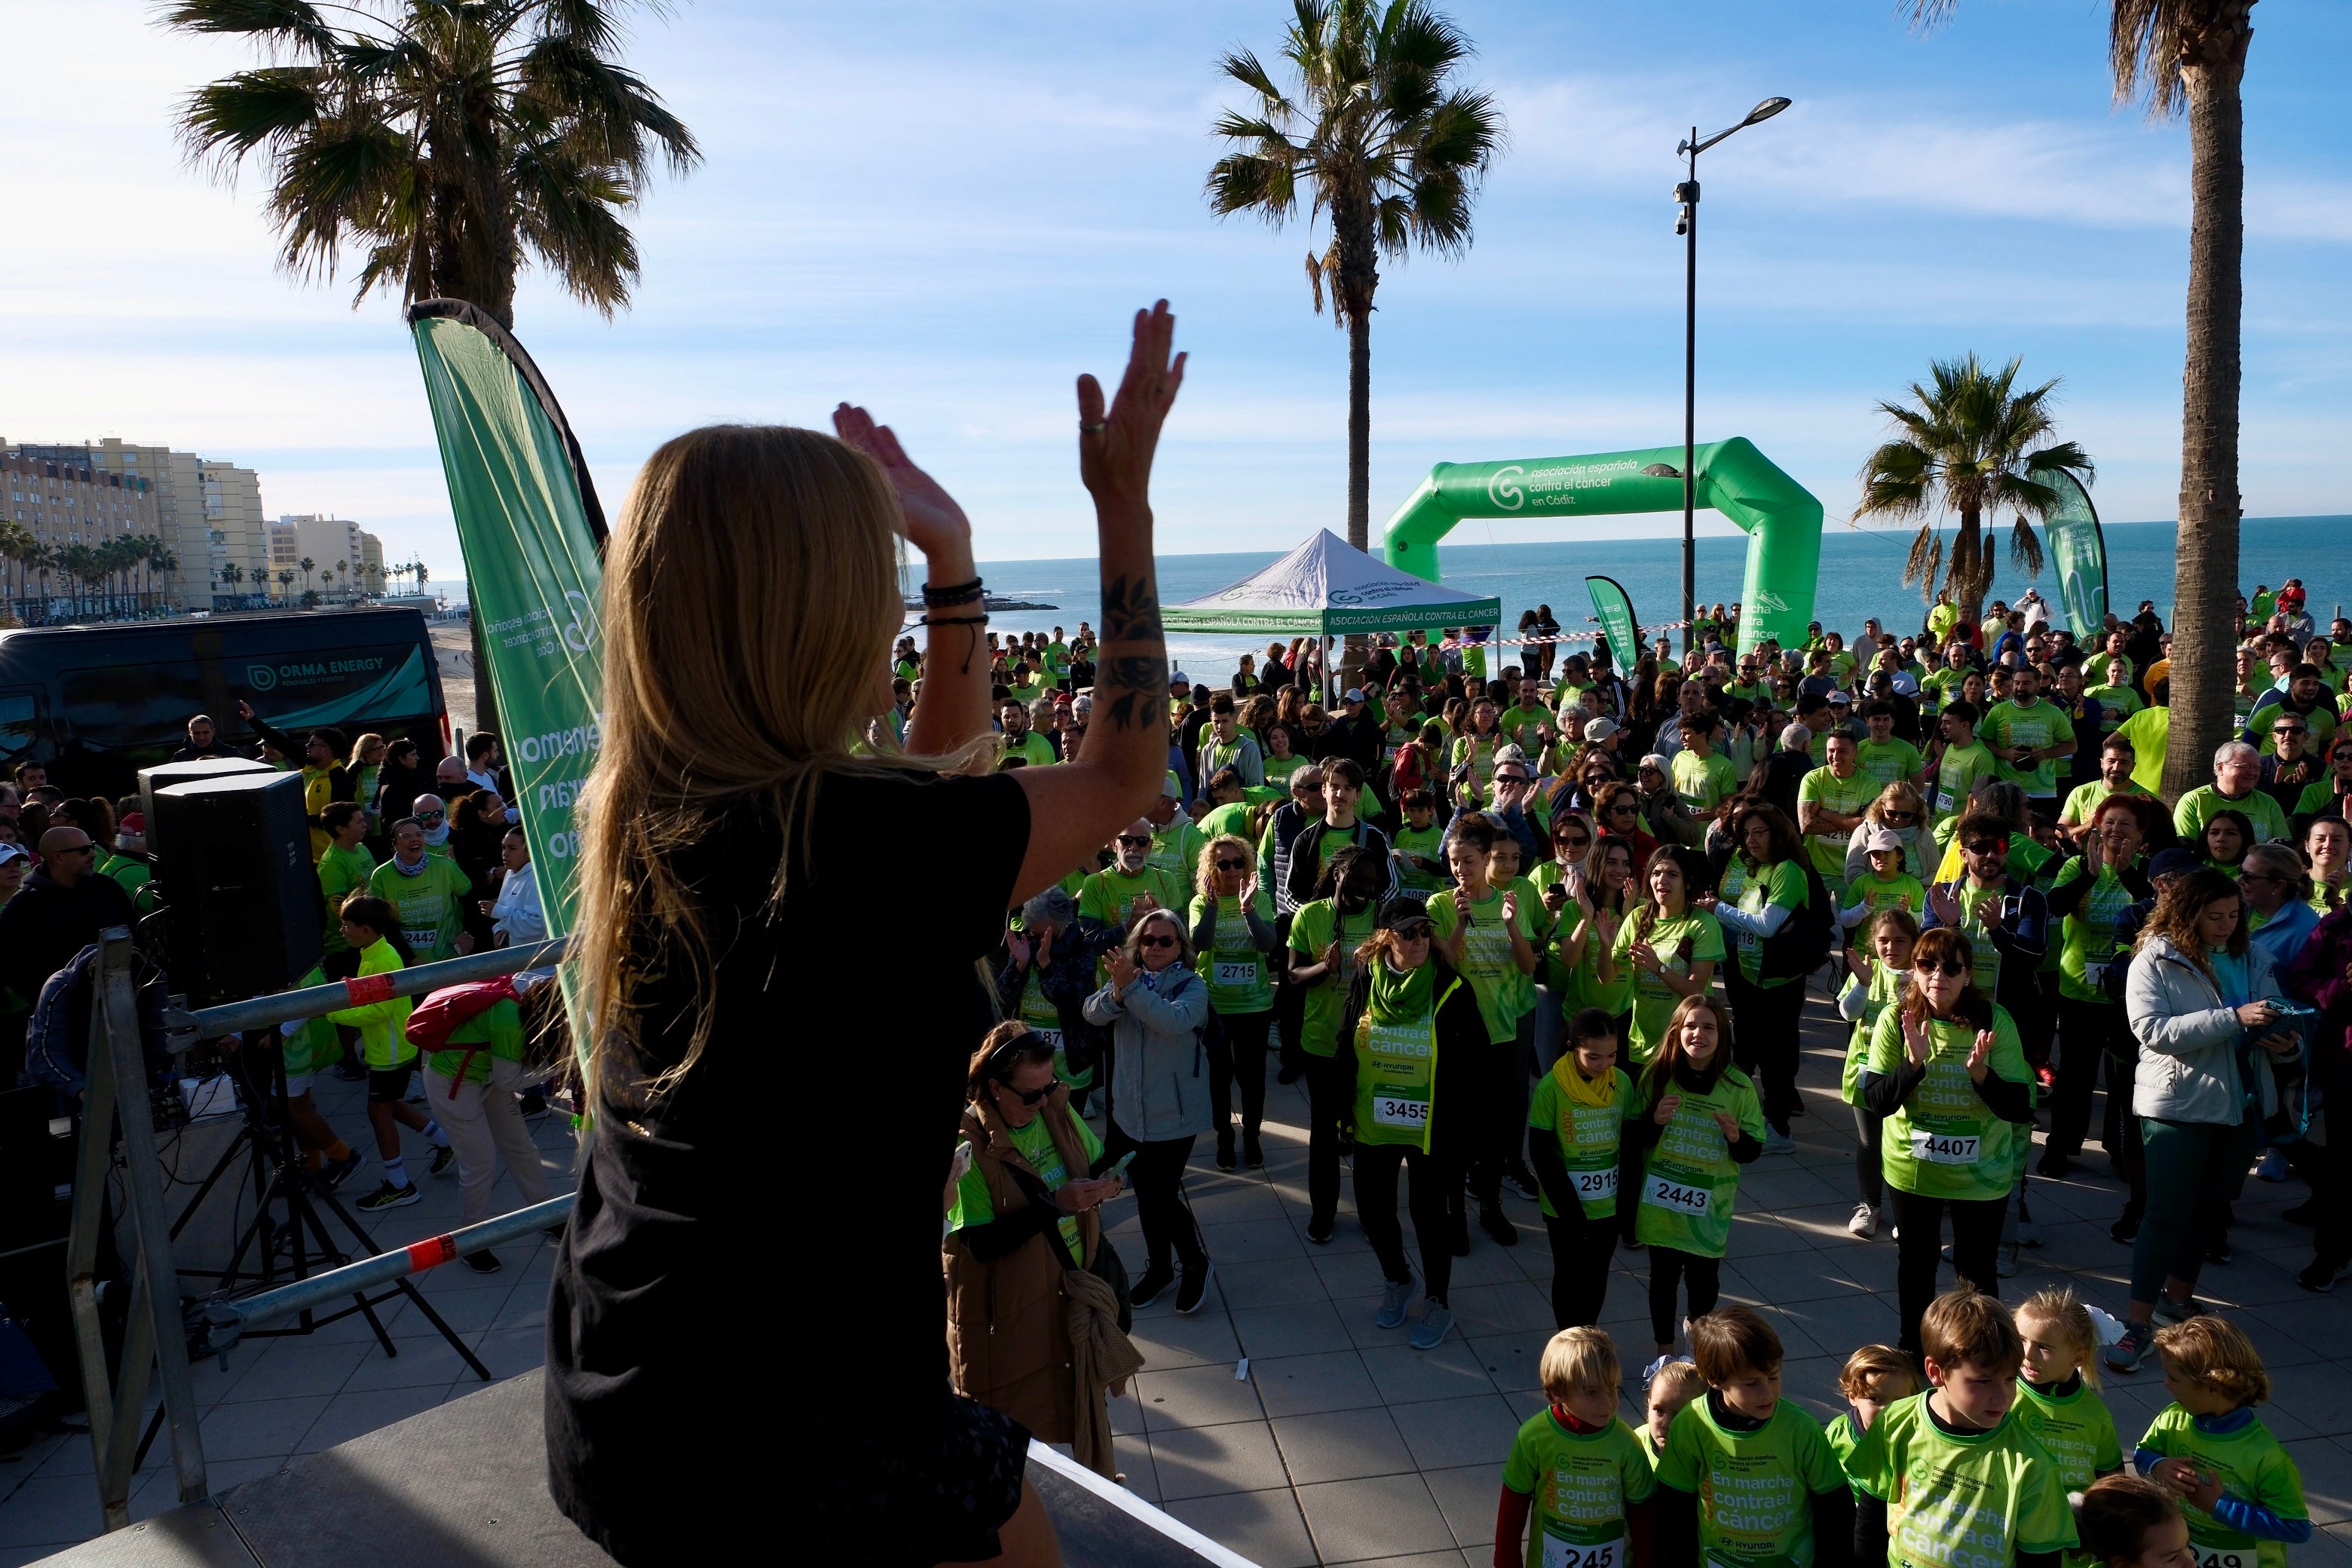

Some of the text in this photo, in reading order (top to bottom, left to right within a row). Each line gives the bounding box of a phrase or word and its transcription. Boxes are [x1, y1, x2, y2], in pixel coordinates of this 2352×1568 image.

[1531, 459, 1638, 478] asociación española
[1529, 476, 1612, 493] contra el cáncer
[1532, 494, 1576, 507] en Cádiz
[1361, 588, 1383, 596] contra
[1162, 616, 1202, 626] SOCIACIÓN
[1243, 617, 1275, 627] CONTRA
[1276, 619, 1286, 627] EL
[1288, 617, 1321, 627] CÁNCER
[1331, 608, 1499, 626] ASOCIACIÓN ESPAÑOLA CONTRA EL CÁNCER
[1740, 616, 1763, 626] ontra
[1743, 627, 1781, 639] cáncer
[280, 657, 383, 678] ORMA ENERGY
[282, 677, 317, 686] RENOVABLES
[411, 896, 442, 906] marcha
[400, 906, 433, 917] contra
[407, 933, 436, 943] 2442
[1465, 928, 1508, 937] En marc
[1466, 939, 1503, 949] contra
[1468, 950, 1509, 962] cánce
[1222, 966, 1254, 978] 2715
[1022, 998, 1056, 1012] cánc
[1040, 1031, 1061, 1044] 87
[1370, 1024, 1430, 1040] contra e
[1940, 1062, 1968, 1073] mar
[1918, 1089, 1982, 1107] cánce
[1385, 1101, 1429, 1119] 3455
[1573, 1107, 1621, 1118] En marcha
[1574, 1117, 1611, 1130] contra
[1686, 1113, 1721, 1130] marc
[1665, 1124, 1713, 1143] contra
[1663, 1138, 1728, 1162] cáncer
[1925, 1137, 1977, 1156] 4407
[1672, 1162, 1704, 1174] HYUNDAI
[1580, 1169, 1618, 1191] 2915
[1656, 1182, 1706, 1208] 2443
[2048, 1438, 2096, 1454] marcha
[2079, 1456, 2092, 1467] el
[1557, 1471, 1573, 1484] En
[1712, 1471, 1794, 1490] En marcha
[1932, 1472, 1952, 1483] contra
[1958, 1480, 1980, 1493] cáncer
[1933, 1465, 1995, 1490] asociación española
[1940, 1481, 1956, 1491] Cádiz
[1557, 1487, 1607, 1502] contra
[1714, 1490, 1792, 1510] contra el
[1909, 1480, 2009, 1530] En marcha
[1717, 1508, 1794, 1530] cáncer
[1565, 1523, 1588, 1531] marcha
[1906, 1508, 2004, 1554] contra el
[1735, 1541, 1775, 1549] HYUNDAI
[1902, 1526, 2004, 1568] cáncer
[1565, 1546, 1612, 1568] 245
